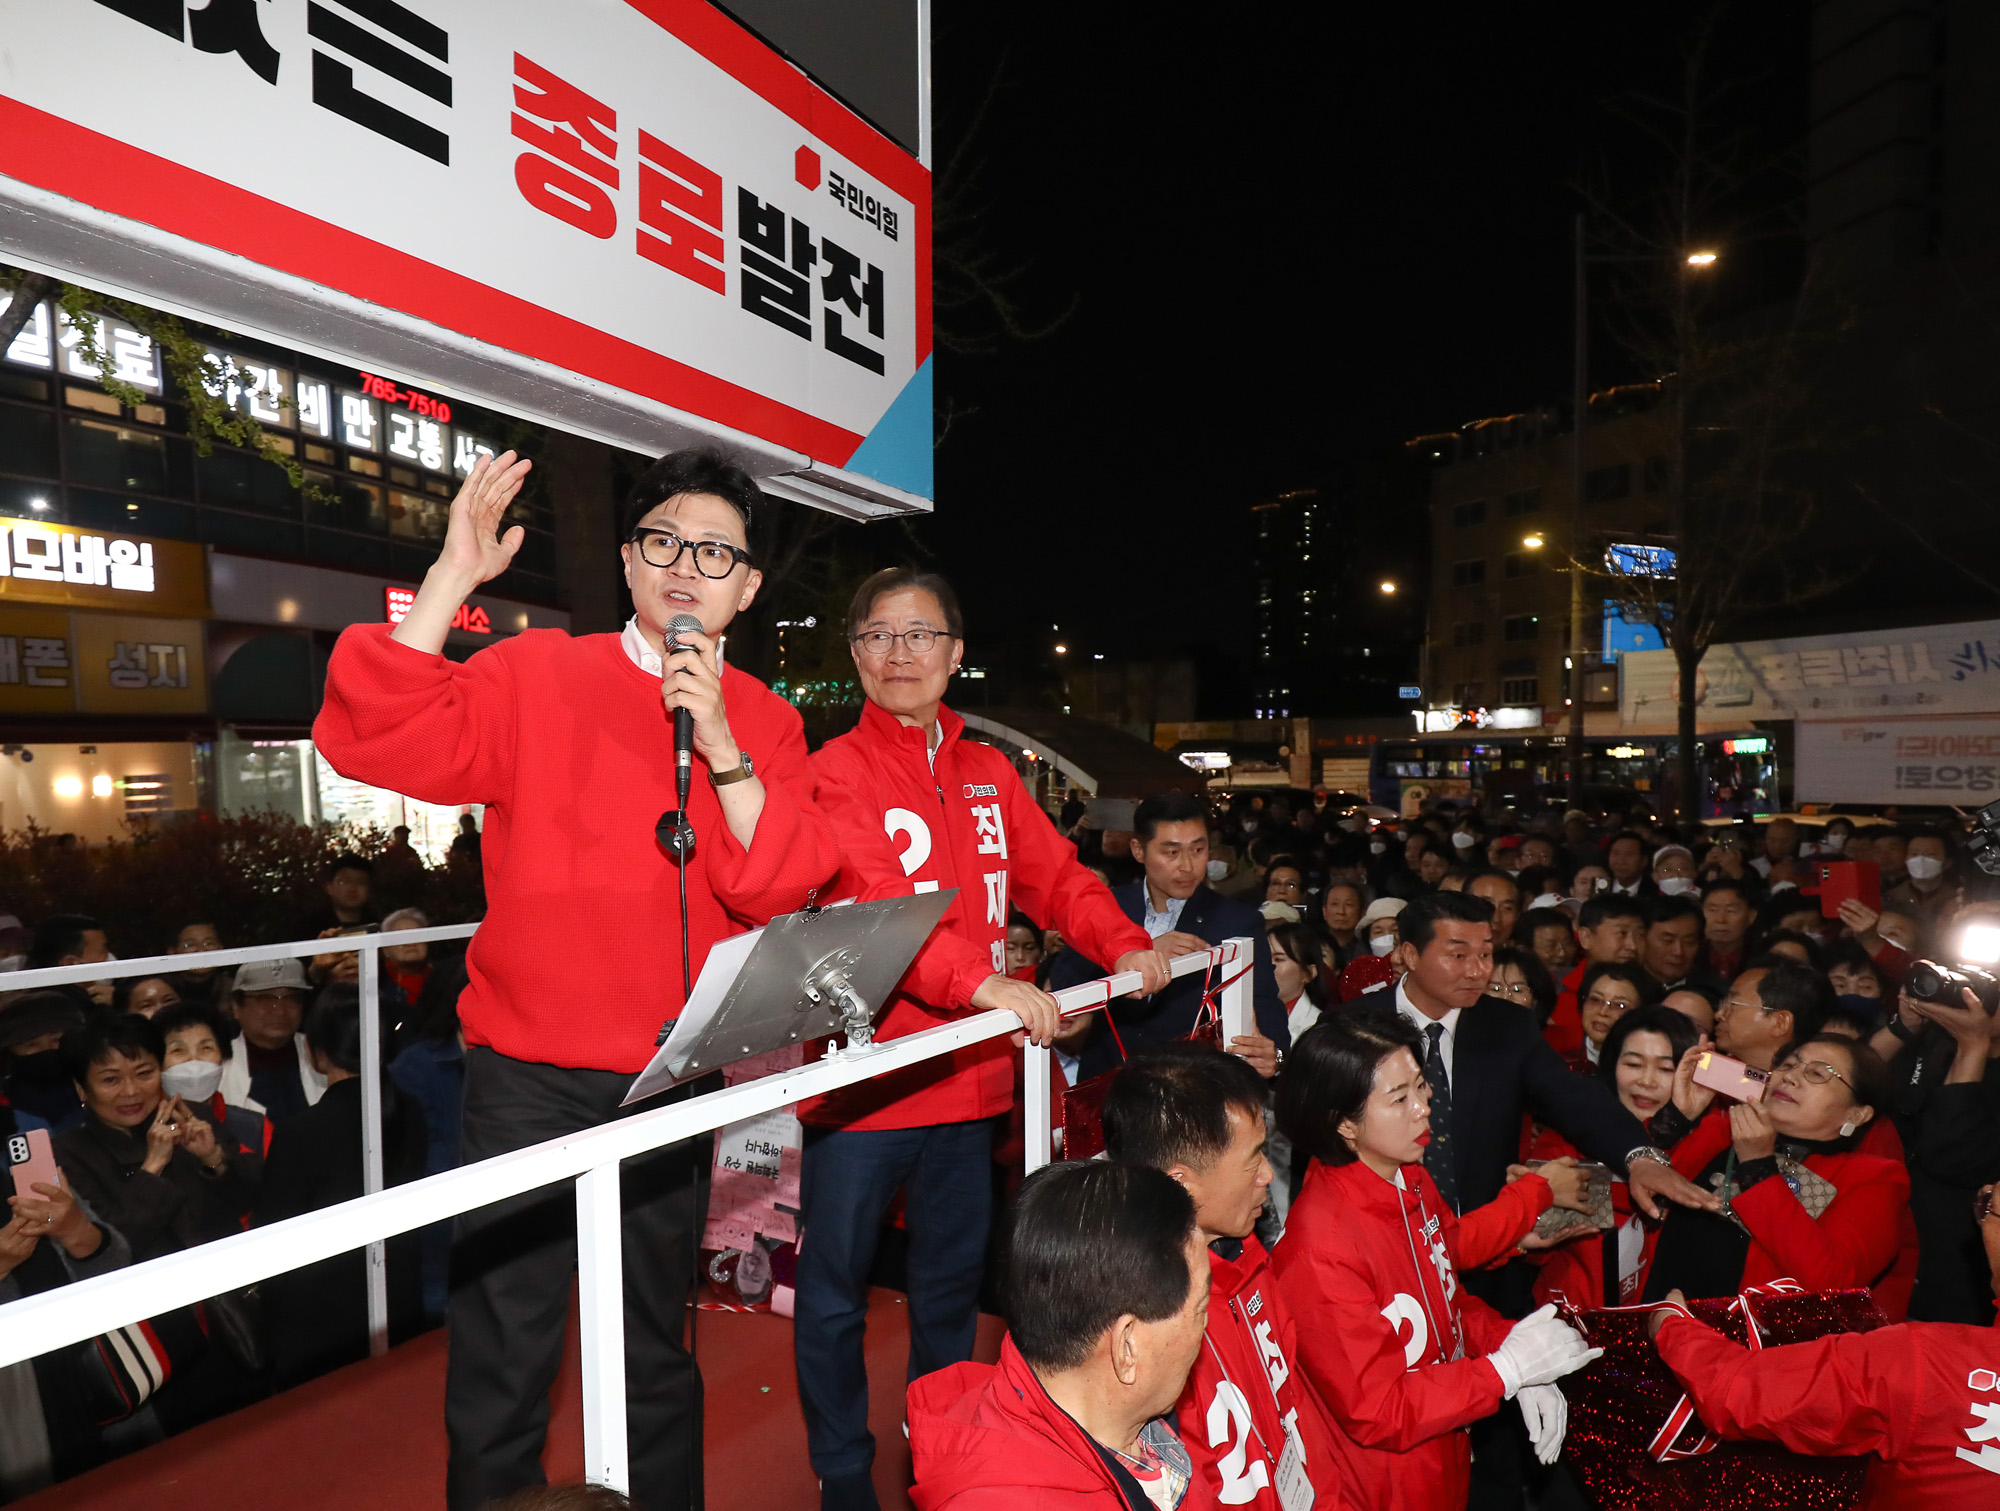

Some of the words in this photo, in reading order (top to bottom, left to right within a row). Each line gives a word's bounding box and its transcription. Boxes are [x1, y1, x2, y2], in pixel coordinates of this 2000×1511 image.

[827, 170, 899, 244] 국민의힘
[359, 371, 452, 424] 765-7510
[0, 525, 155, 592] 모바일
[108, 642, 190, 688] 성지
[884, 807, 940, 895] 2
[745, 1138, 783, 1158] 하합니다
[1206, 1380, 1270, 1505] 2
